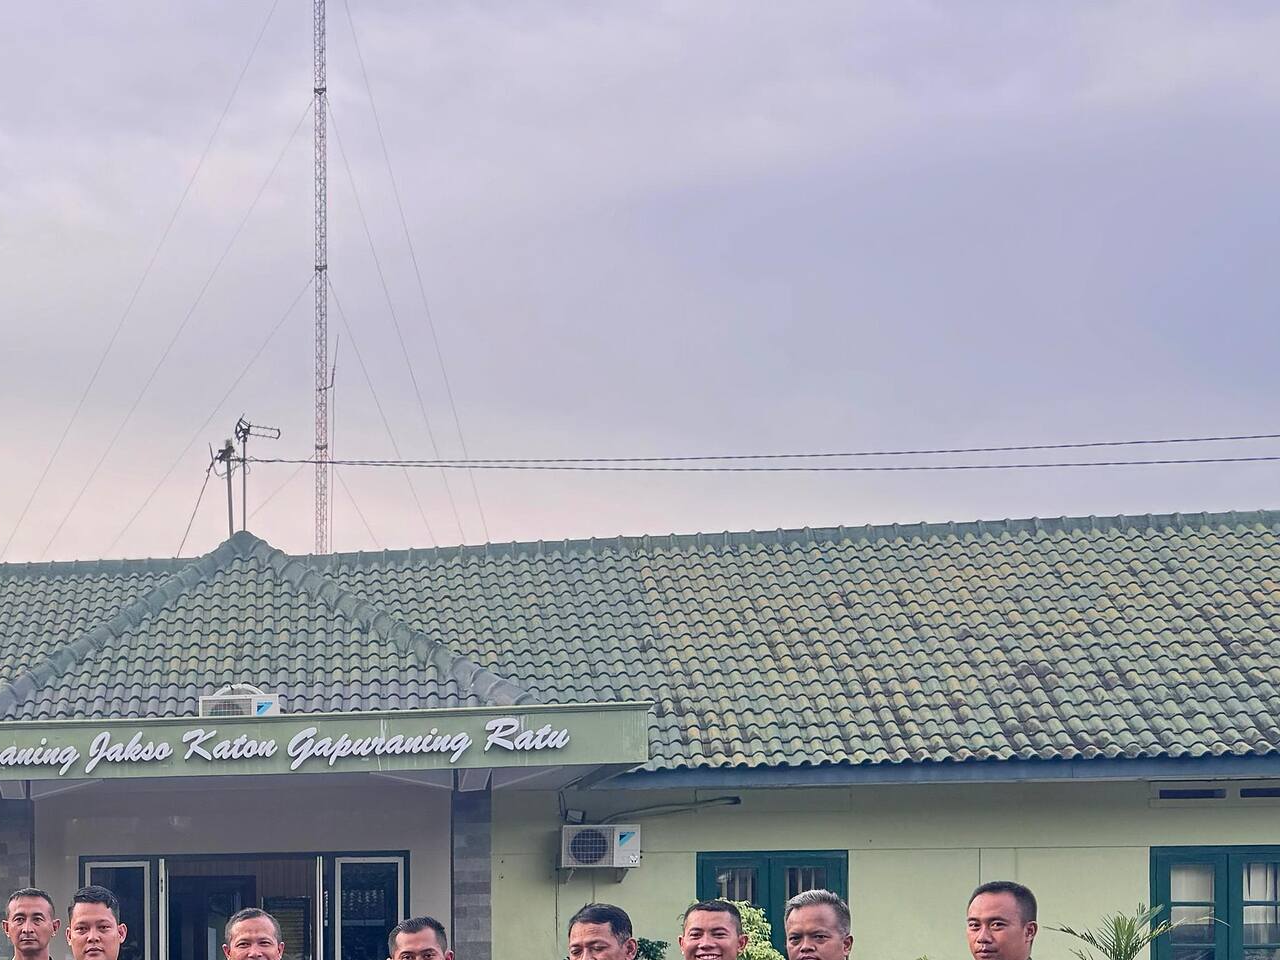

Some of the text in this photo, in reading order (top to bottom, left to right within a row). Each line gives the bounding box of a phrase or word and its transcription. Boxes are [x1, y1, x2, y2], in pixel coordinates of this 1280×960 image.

[84, 731, 174, 775] Jakso
[180, 728, 277, 761] Katon
[286, 727, 474, 771] Gapuraning
[483, 716, 571, 753] Ratu
